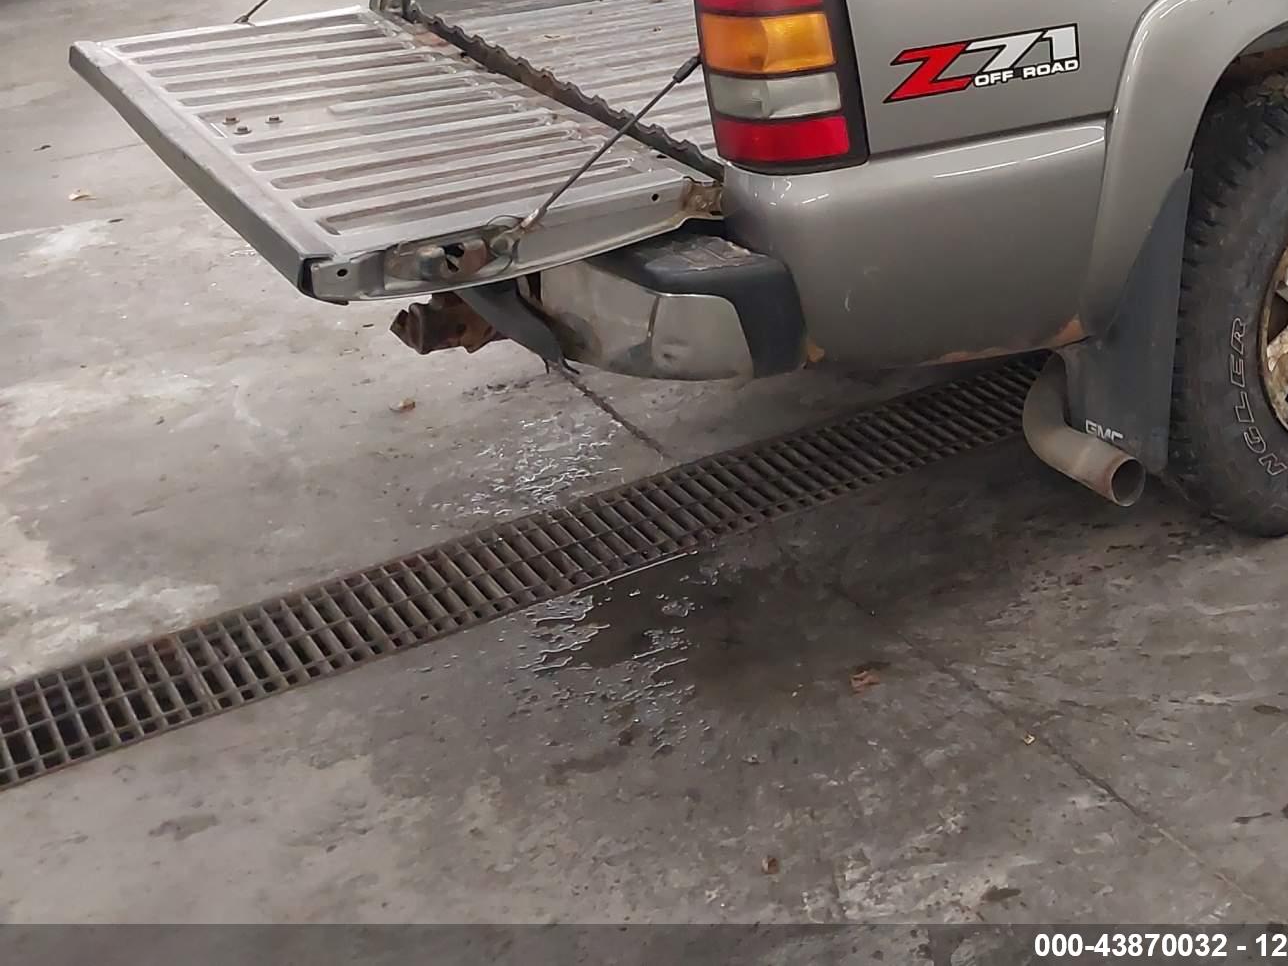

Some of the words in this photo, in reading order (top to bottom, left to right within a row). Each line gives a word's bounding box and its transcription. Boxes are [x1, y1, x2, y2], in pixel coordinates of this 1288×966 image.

[883, 23, 1080, 103] Z71
[974, 69, 1015, 88] OFF
[1022, 58, 1080, 80] ROAD
